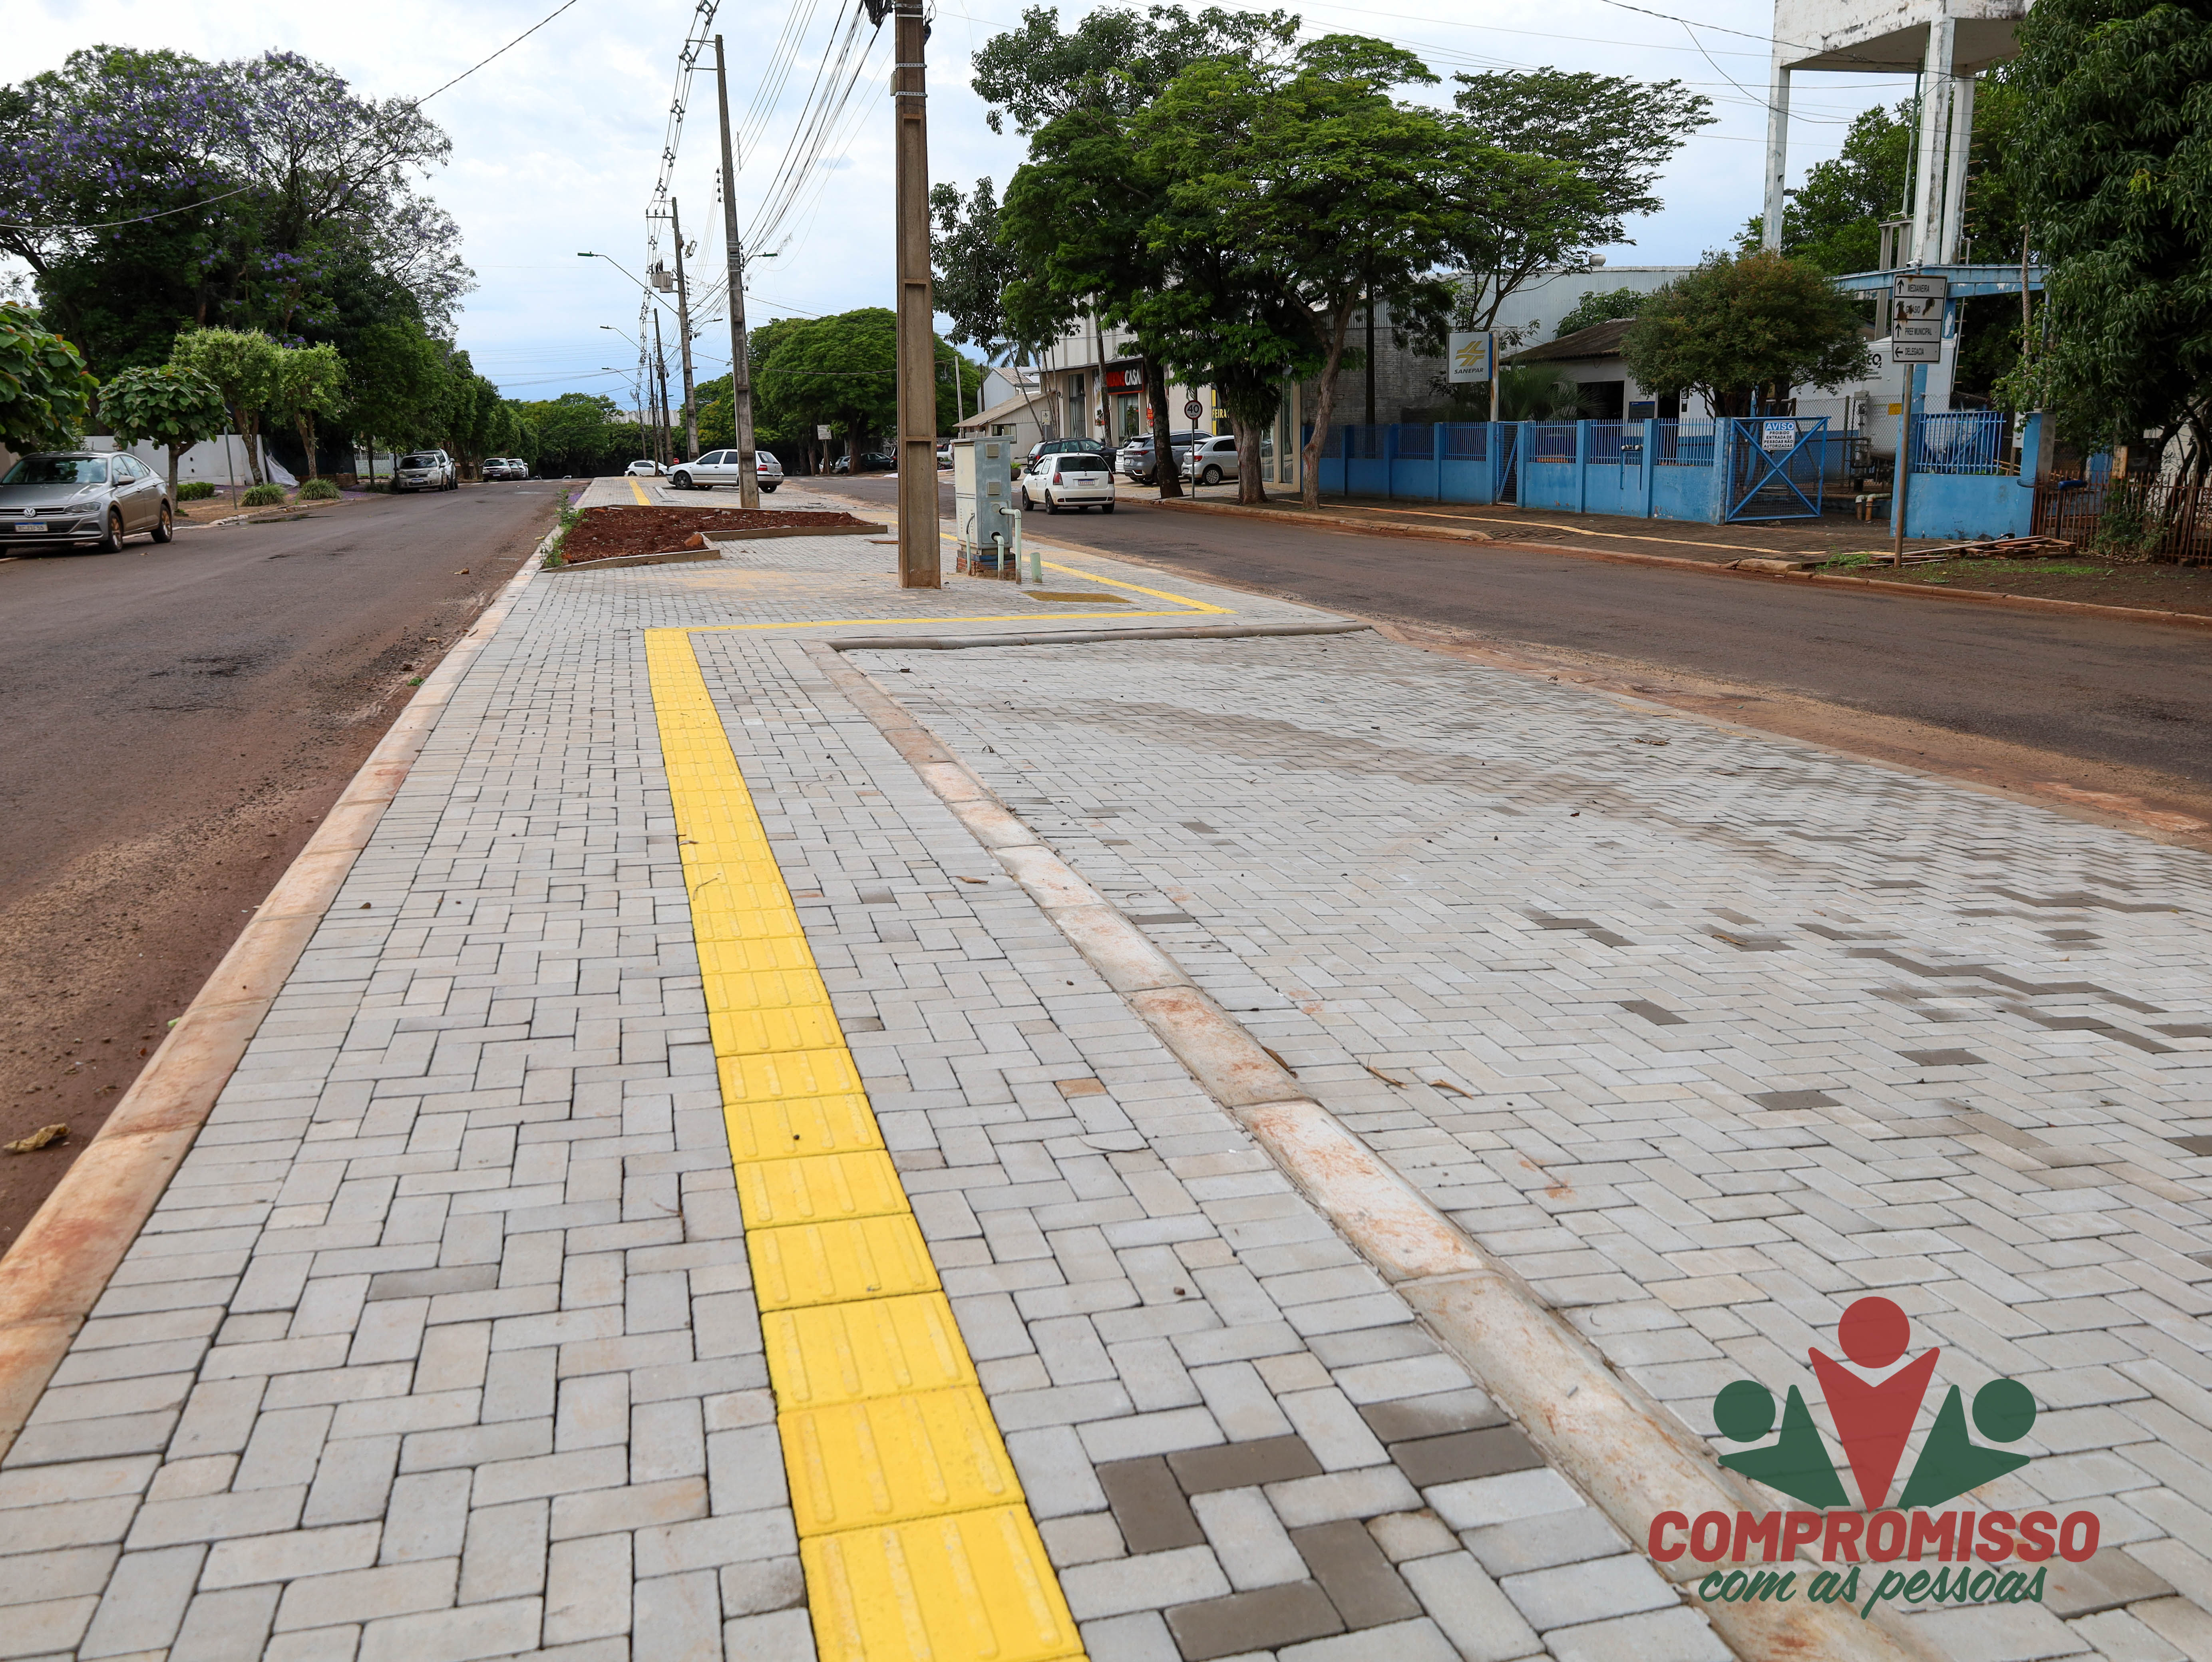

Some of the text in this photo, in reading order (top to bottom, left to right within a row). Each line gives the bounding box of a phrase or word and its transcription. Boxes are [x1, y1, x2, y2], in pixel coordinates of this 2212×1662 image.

[1908, 284, 1930, 292] MEDIANEIRA
[1125, 368, 1142, 386] CASA
[1187, 405, 1199, 413] 40
